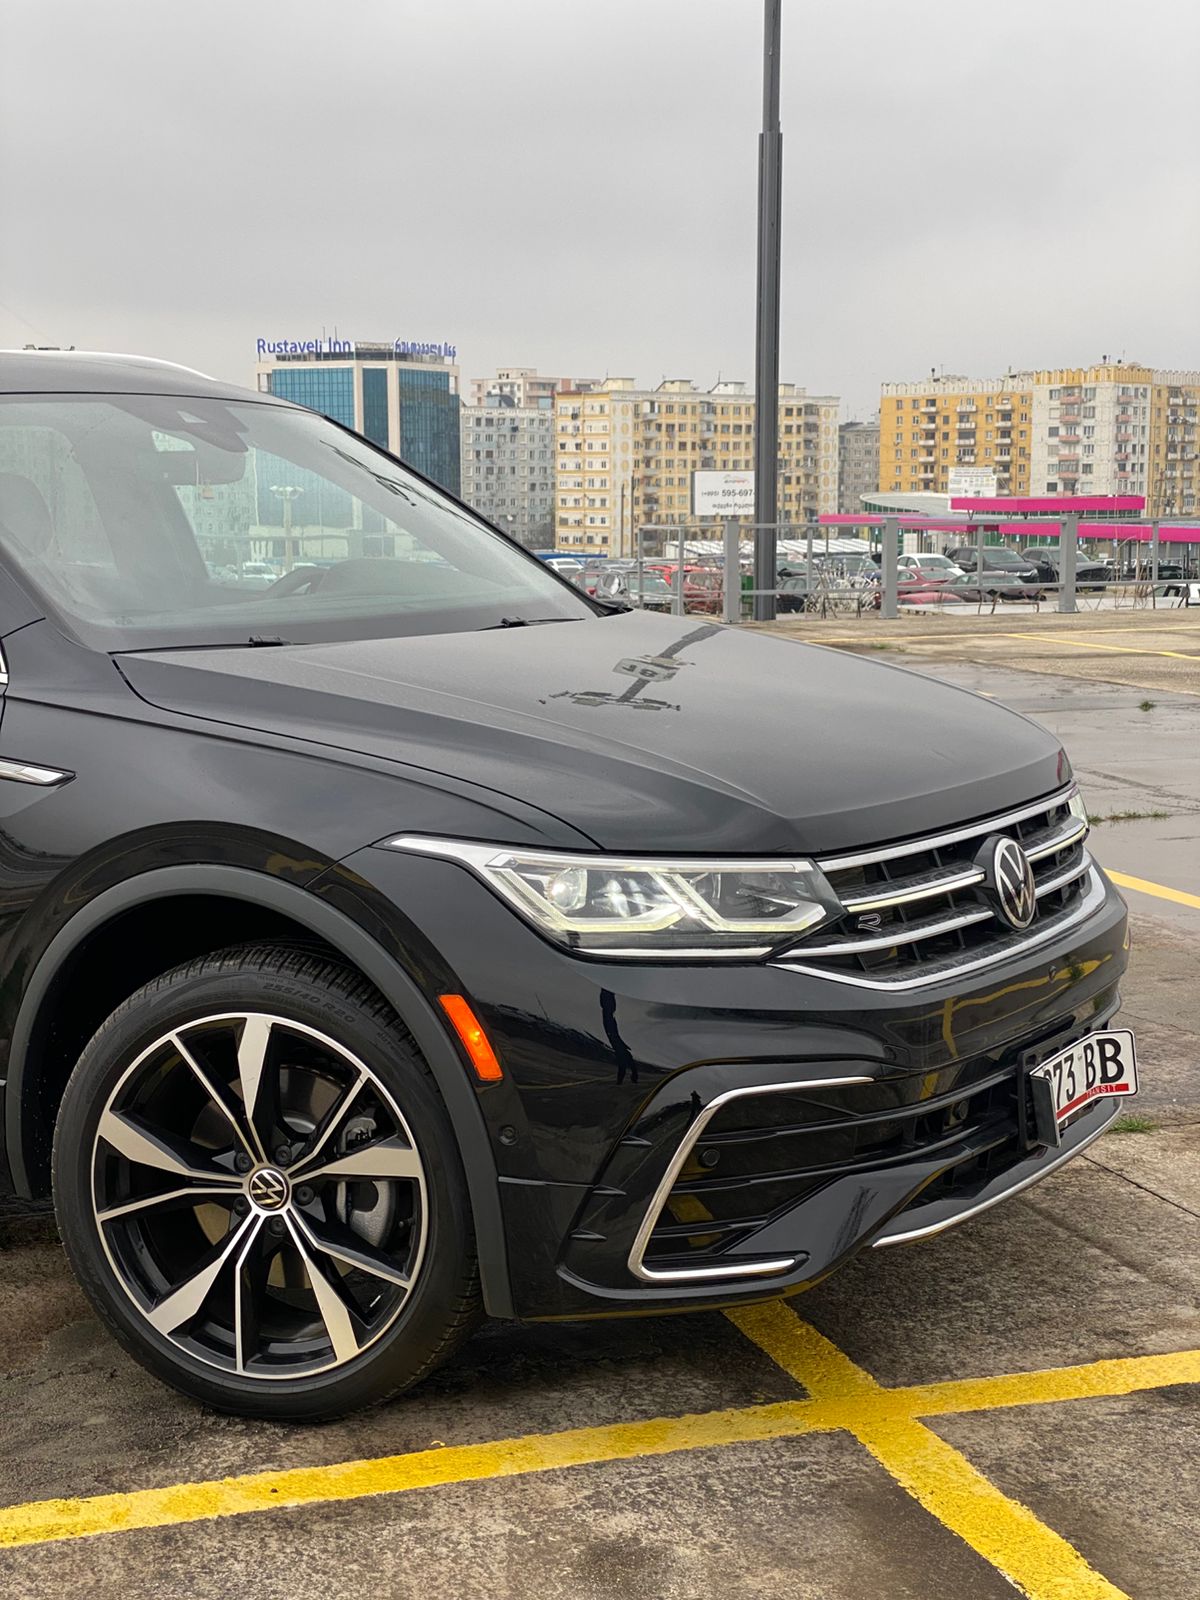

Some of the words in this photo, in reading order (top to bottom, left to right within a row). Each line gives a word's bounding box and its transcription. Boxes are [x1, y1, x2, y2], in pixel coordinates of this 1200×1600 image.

[257, 338, 322, 353] Rustaveli
[328, 337, 351, 353] Inn
[721, 489, 755, 497] 595-697
[857, 912, 882, 932] R
[1044, 1052, 1076, 1110] 73
[1083, 1038, 1125, 1091] BB
[1086, 1084, 1118, 1099] TRANSIT
